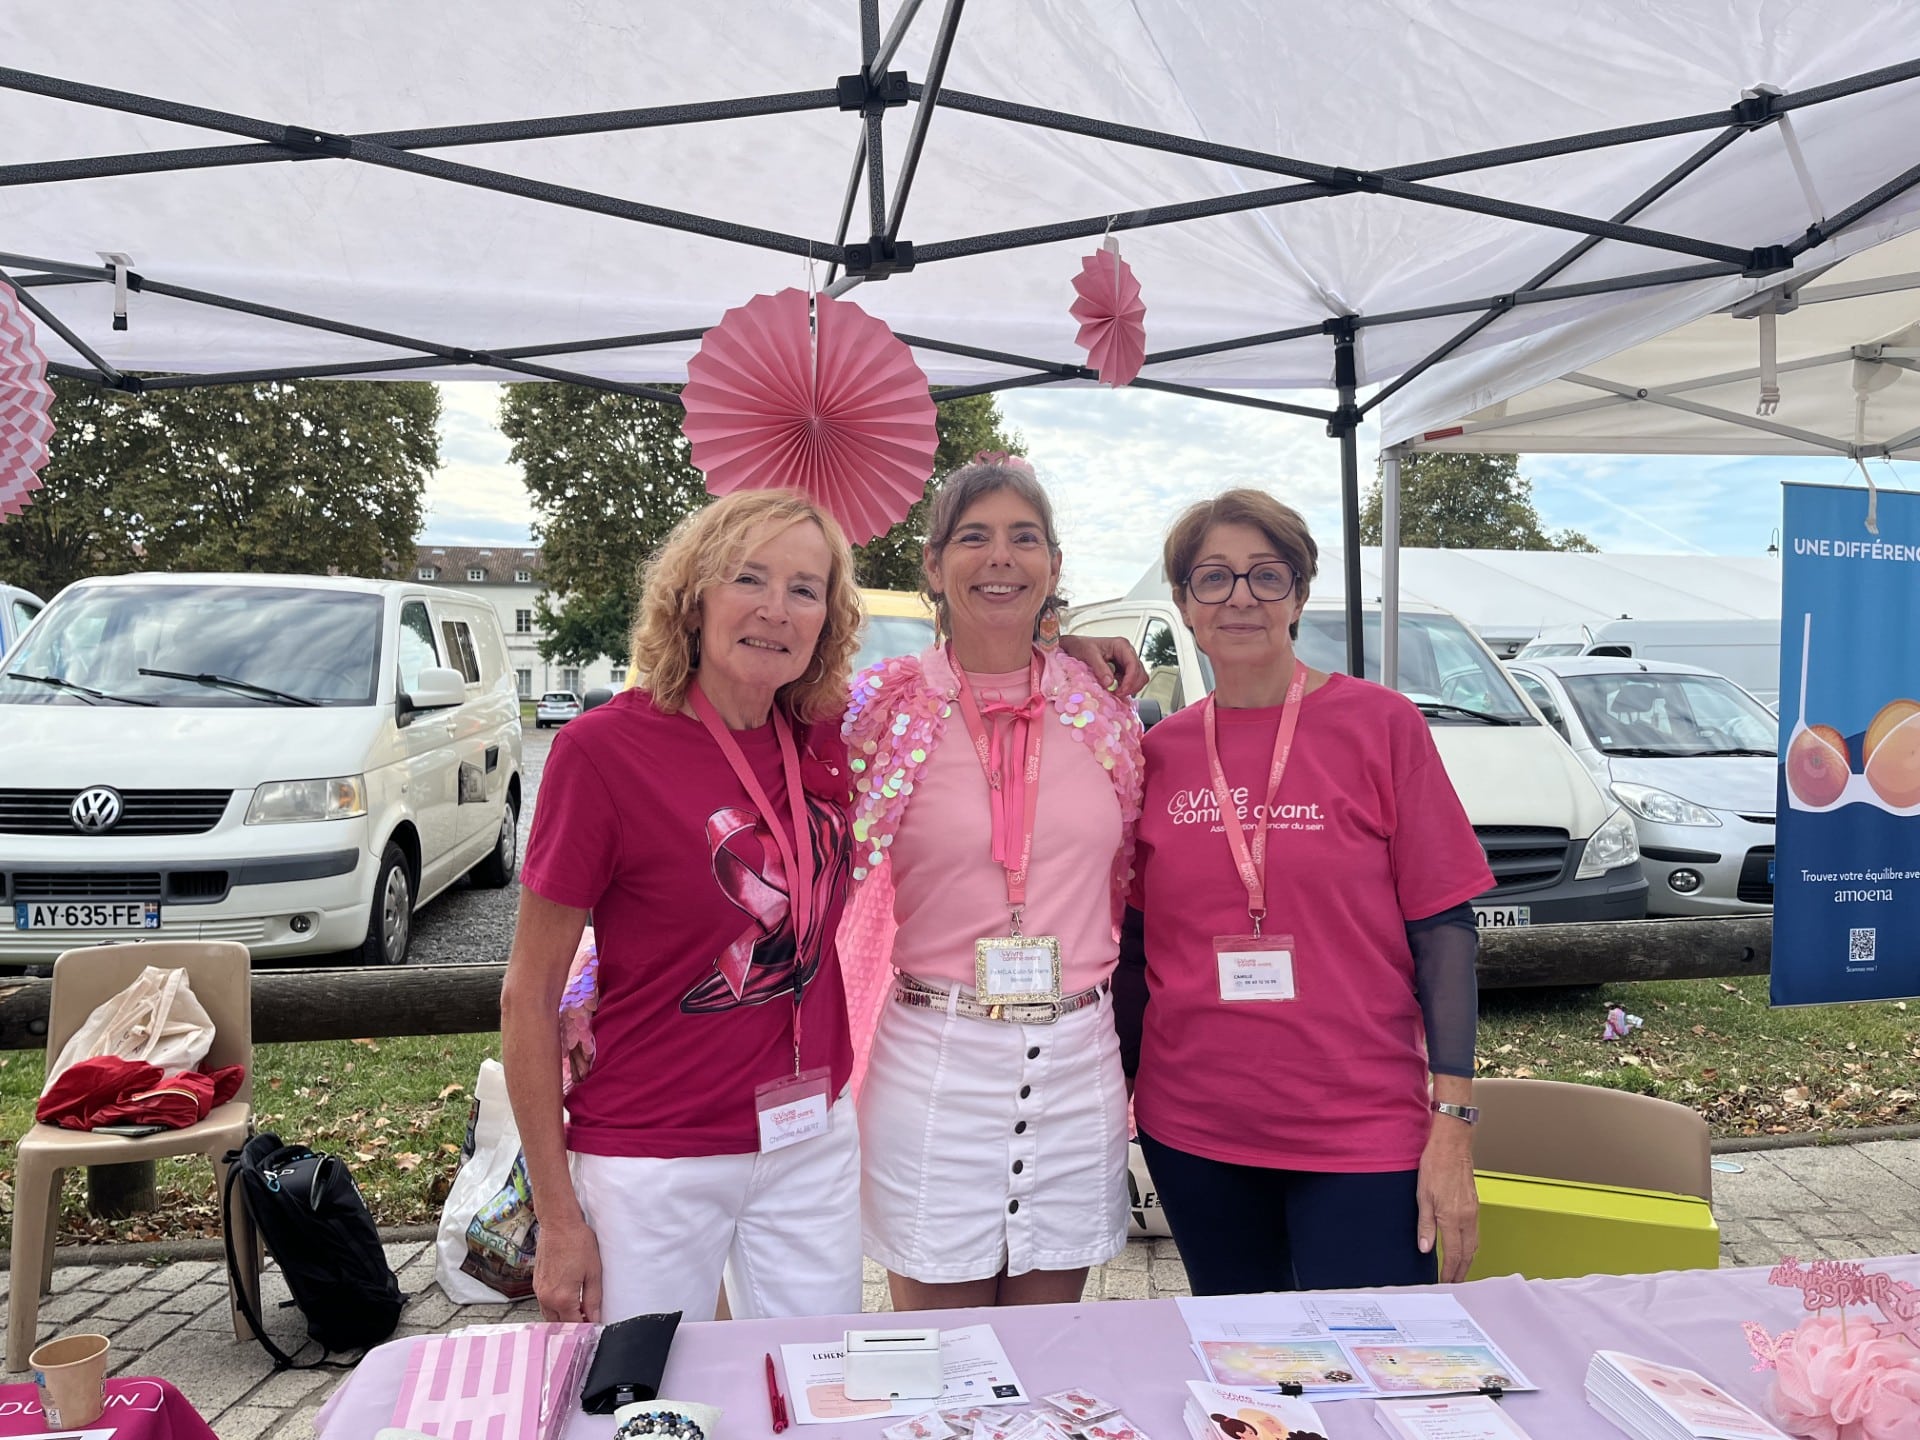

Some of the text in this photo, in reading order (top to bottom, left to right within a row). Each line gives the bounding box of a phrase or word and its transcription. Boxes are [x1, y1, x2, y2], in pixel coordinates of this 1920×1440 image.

[1794, 538, 1830, 556] UNE
[1173, 805, 1248, 825] come
[1265, 823, 1290, 831] ancer
[1291, 822, 1303, 830] du
[1305, 823, 1324, 831] sein
[1801, 870, 1837, 881] Trouvez
[1840, 872, 1863, 881] votre
[1865, 867, 1903, 883] équilibre
[1834, 889, 1893, 902] amoena
[33, 905, 141, 926] AY-635-FE
